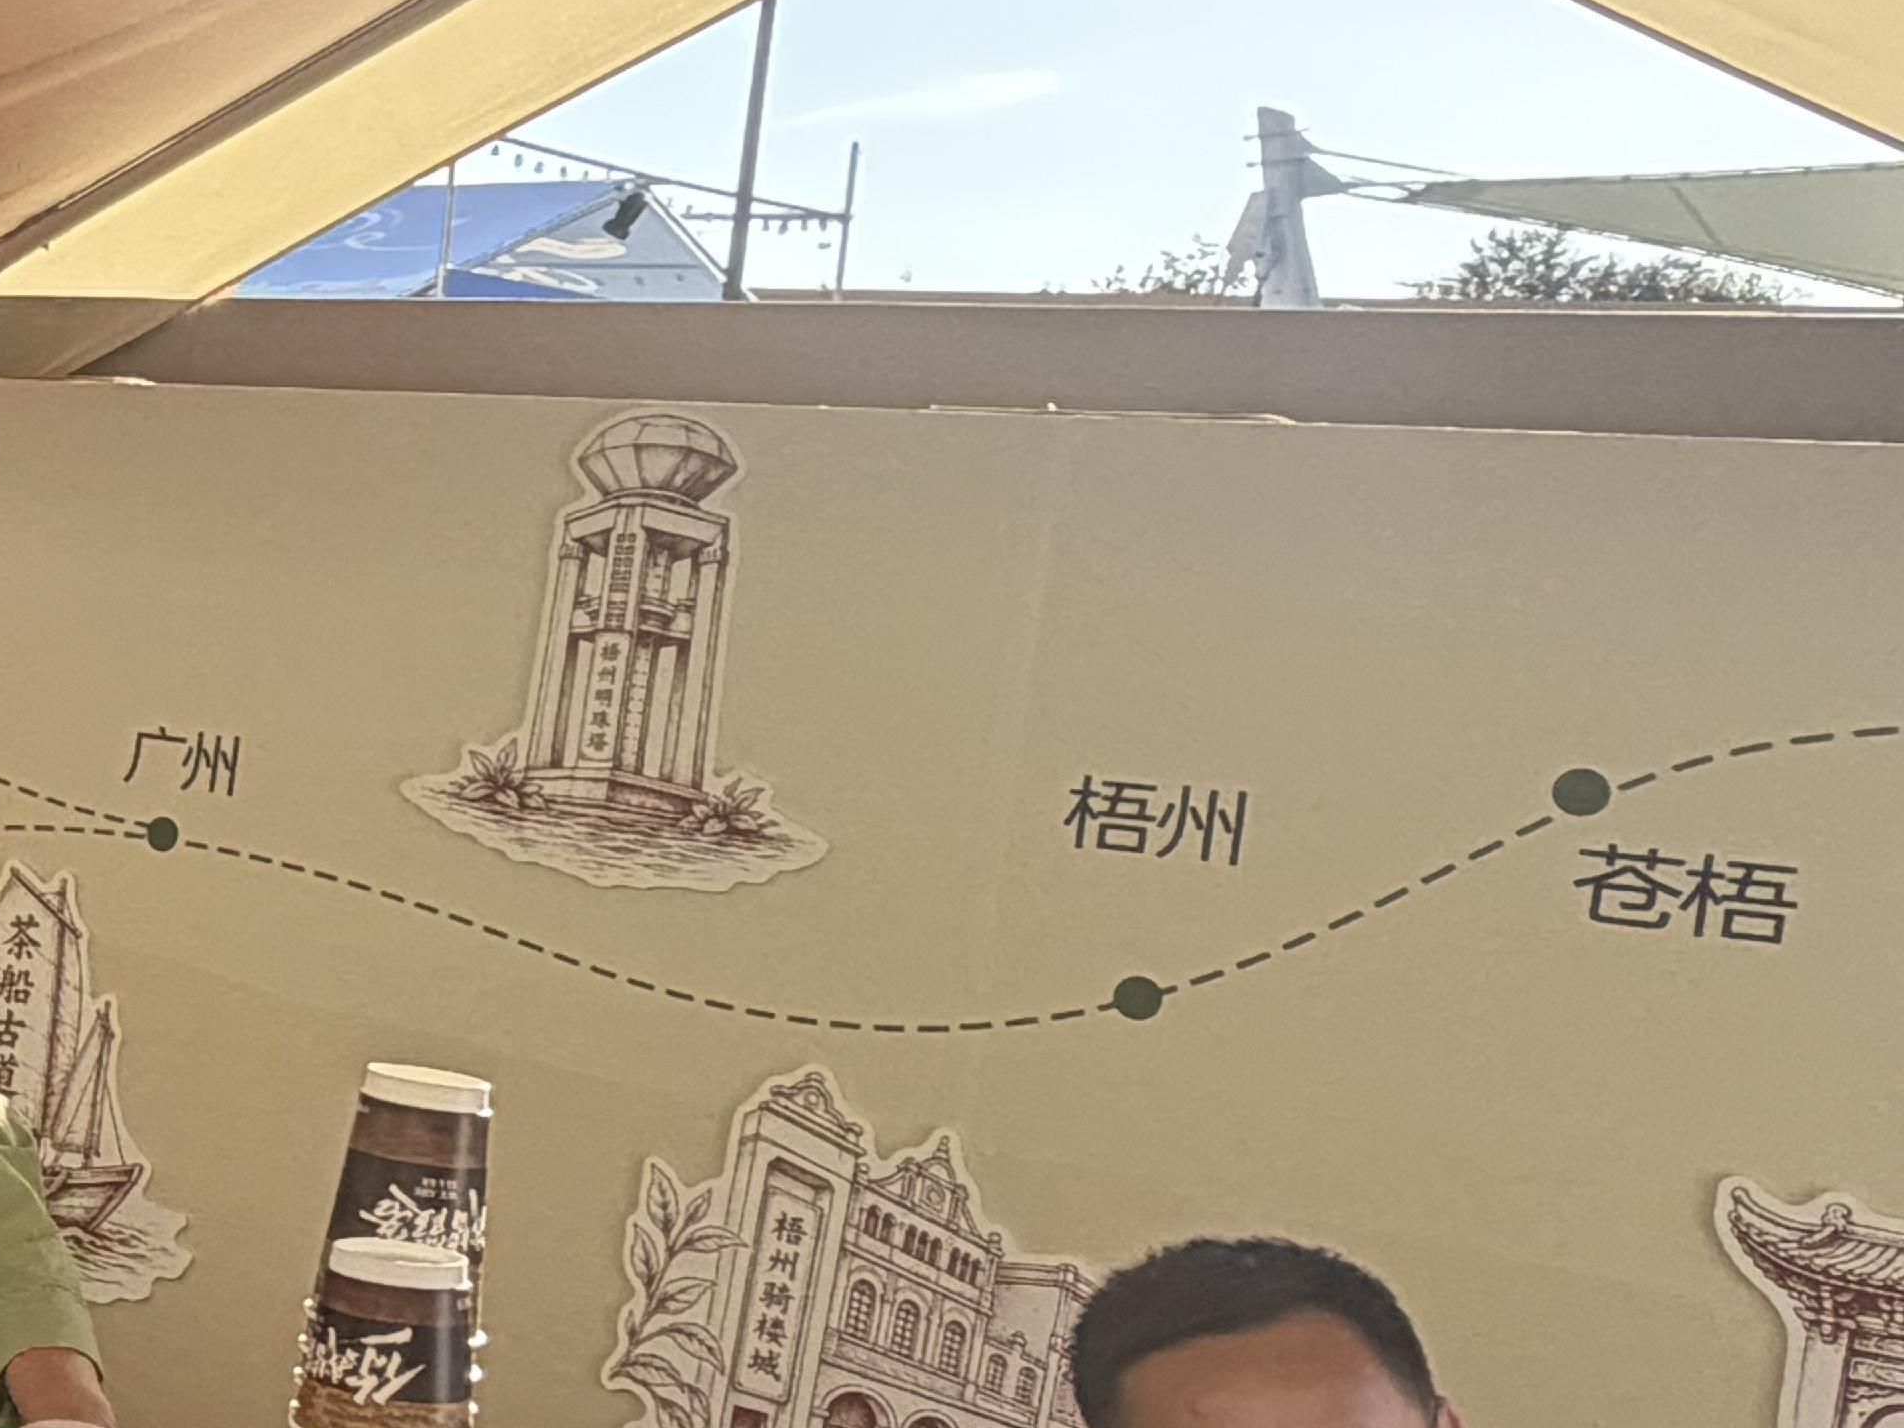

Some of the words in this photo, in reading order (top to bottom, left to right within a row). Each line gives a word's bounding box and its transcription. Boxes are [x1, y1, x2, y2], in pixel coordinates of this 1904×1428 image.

[122, 725, 242, 799] 广州
[1063, 774, 1248, 867] 梧州
[1573, 842, 1799, 945] 苍梧
[746, 1210, 808, 1383] 梧州骑楼城
